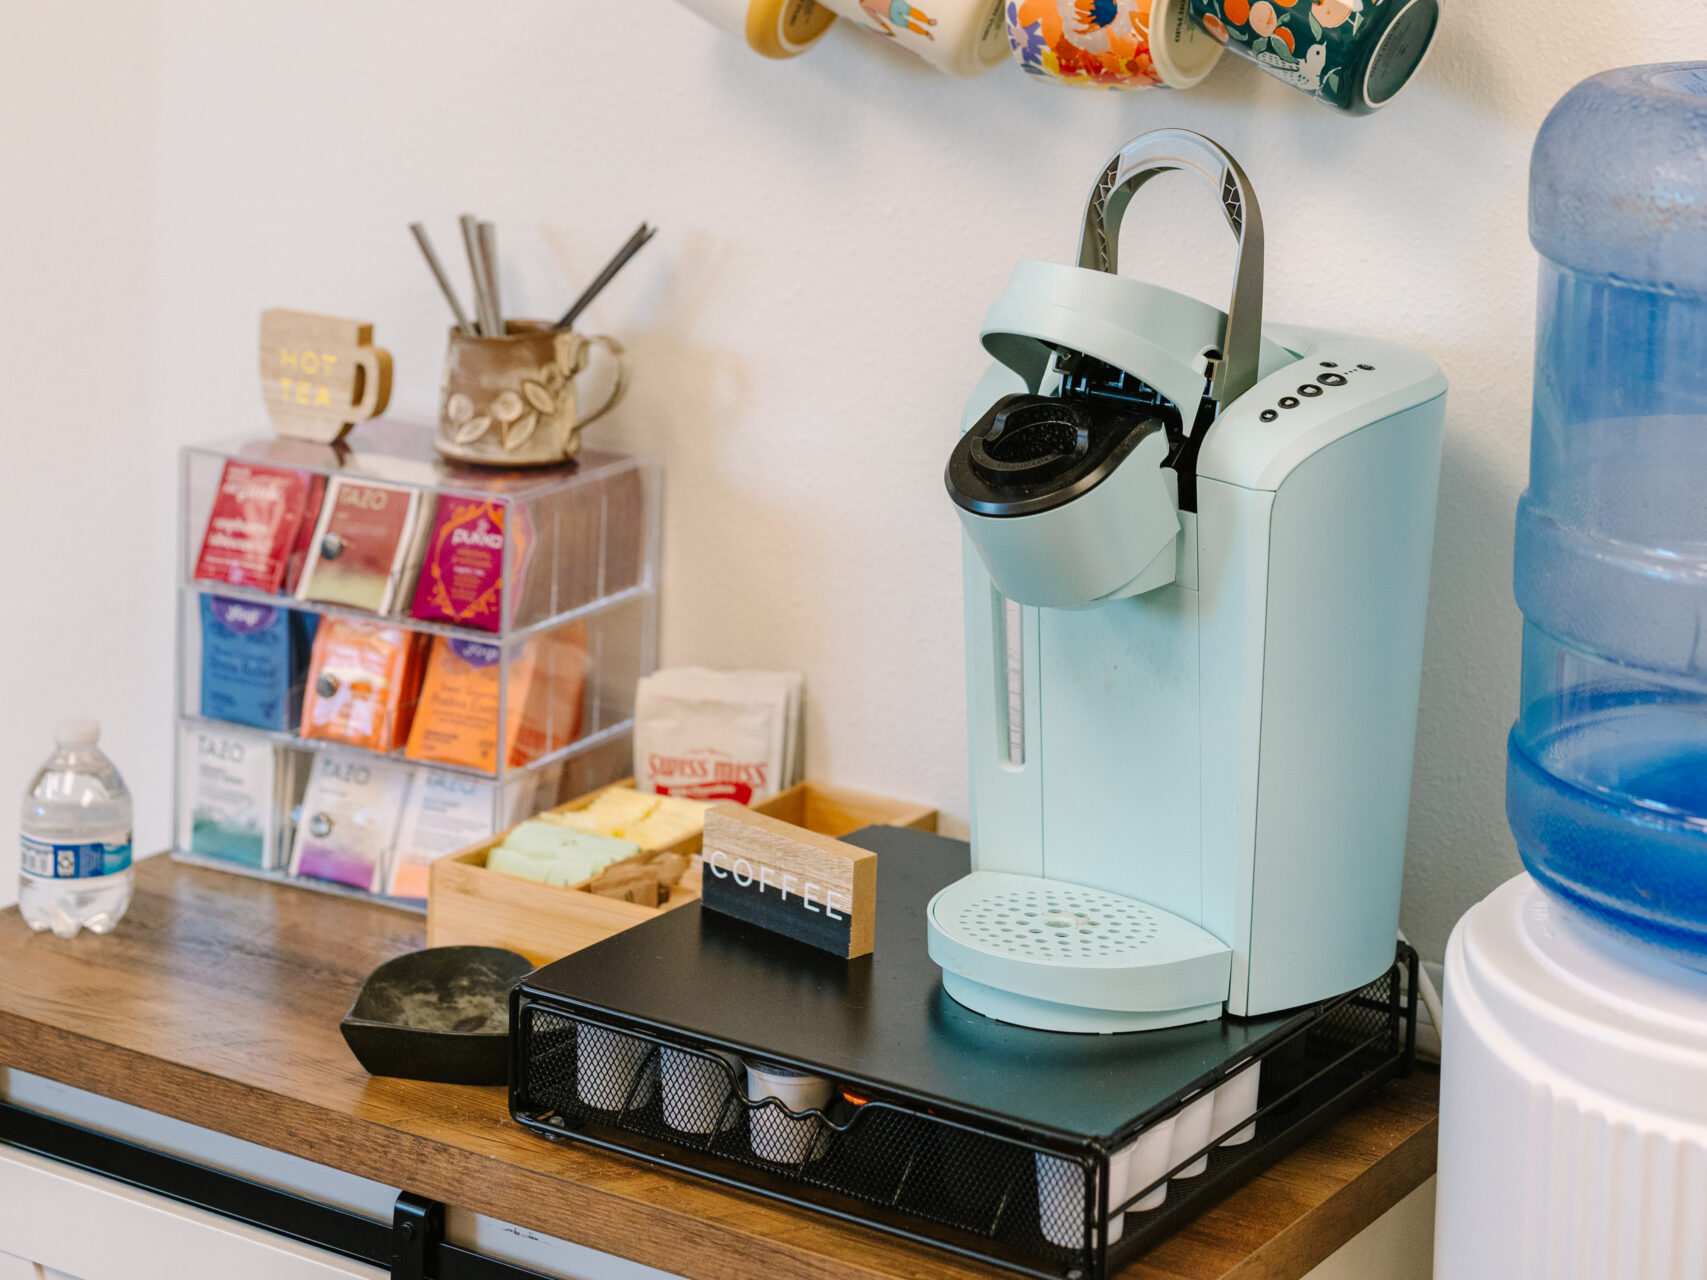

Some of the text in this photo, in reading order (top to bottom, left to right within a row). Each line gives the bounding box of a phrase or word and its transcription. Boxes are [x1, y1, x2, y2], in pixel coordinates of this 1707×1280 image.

[280, 346, 338, 377] HOT
[280, 377, 332, 408] TEA
[338, 483, 389, 511] TAZO
[709, 849, 843, 921] COFFEE
